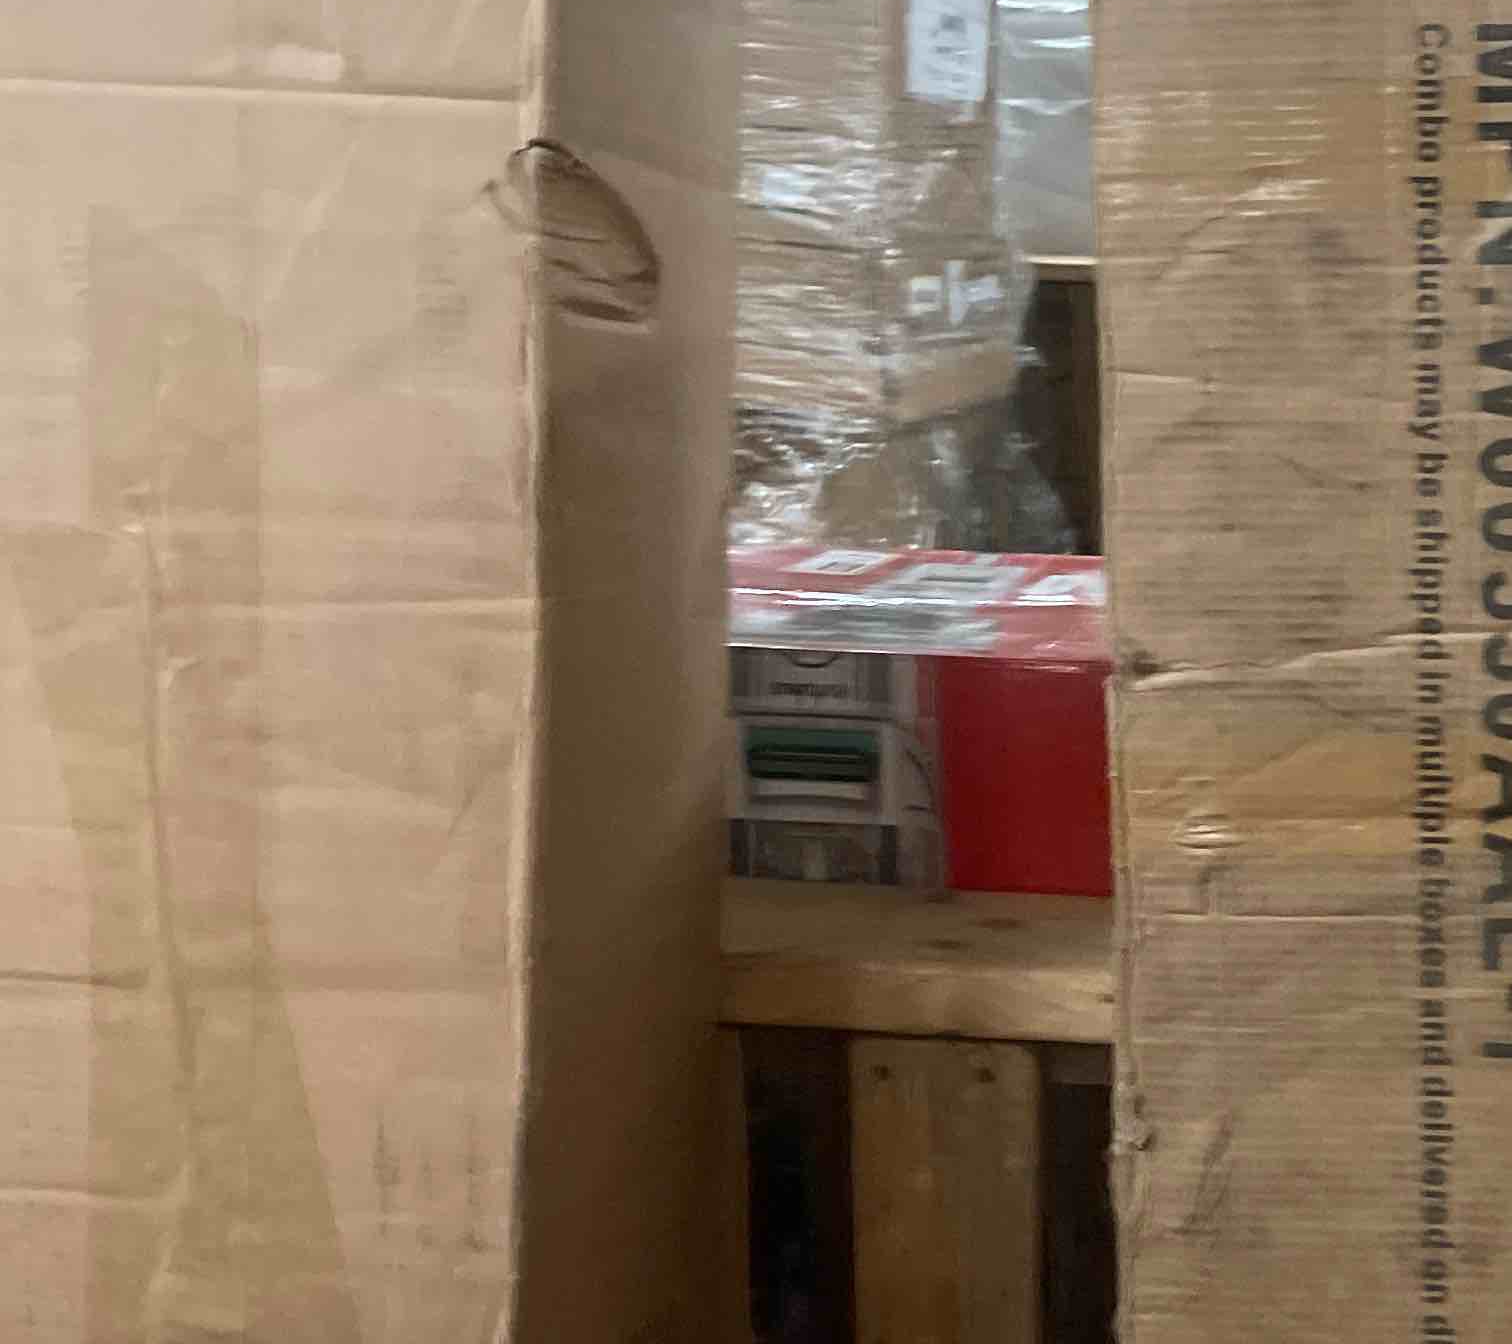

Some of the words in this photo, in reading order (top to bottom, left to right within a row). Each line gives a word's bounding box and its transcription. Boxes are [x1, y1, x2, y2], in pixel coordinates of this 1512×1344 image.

[1415, 21, 1451, 161] Combo
[1408, 174, 1452, 350] products
[1408, 362, 1446, 438] may
[1415, 452, 1452, 498] be
[1408, 508, 1453, 659] shipped
[1416, 671, 1452, 704] in
[1411, 715, 1454, 865] multiple
[1418, 878, 1453, 989] boxes
[1420, 998, 1455, 1066] and
[1420, 1075, 1456, 1250] delivered
[1420, 1258, 1450, 1305] on
